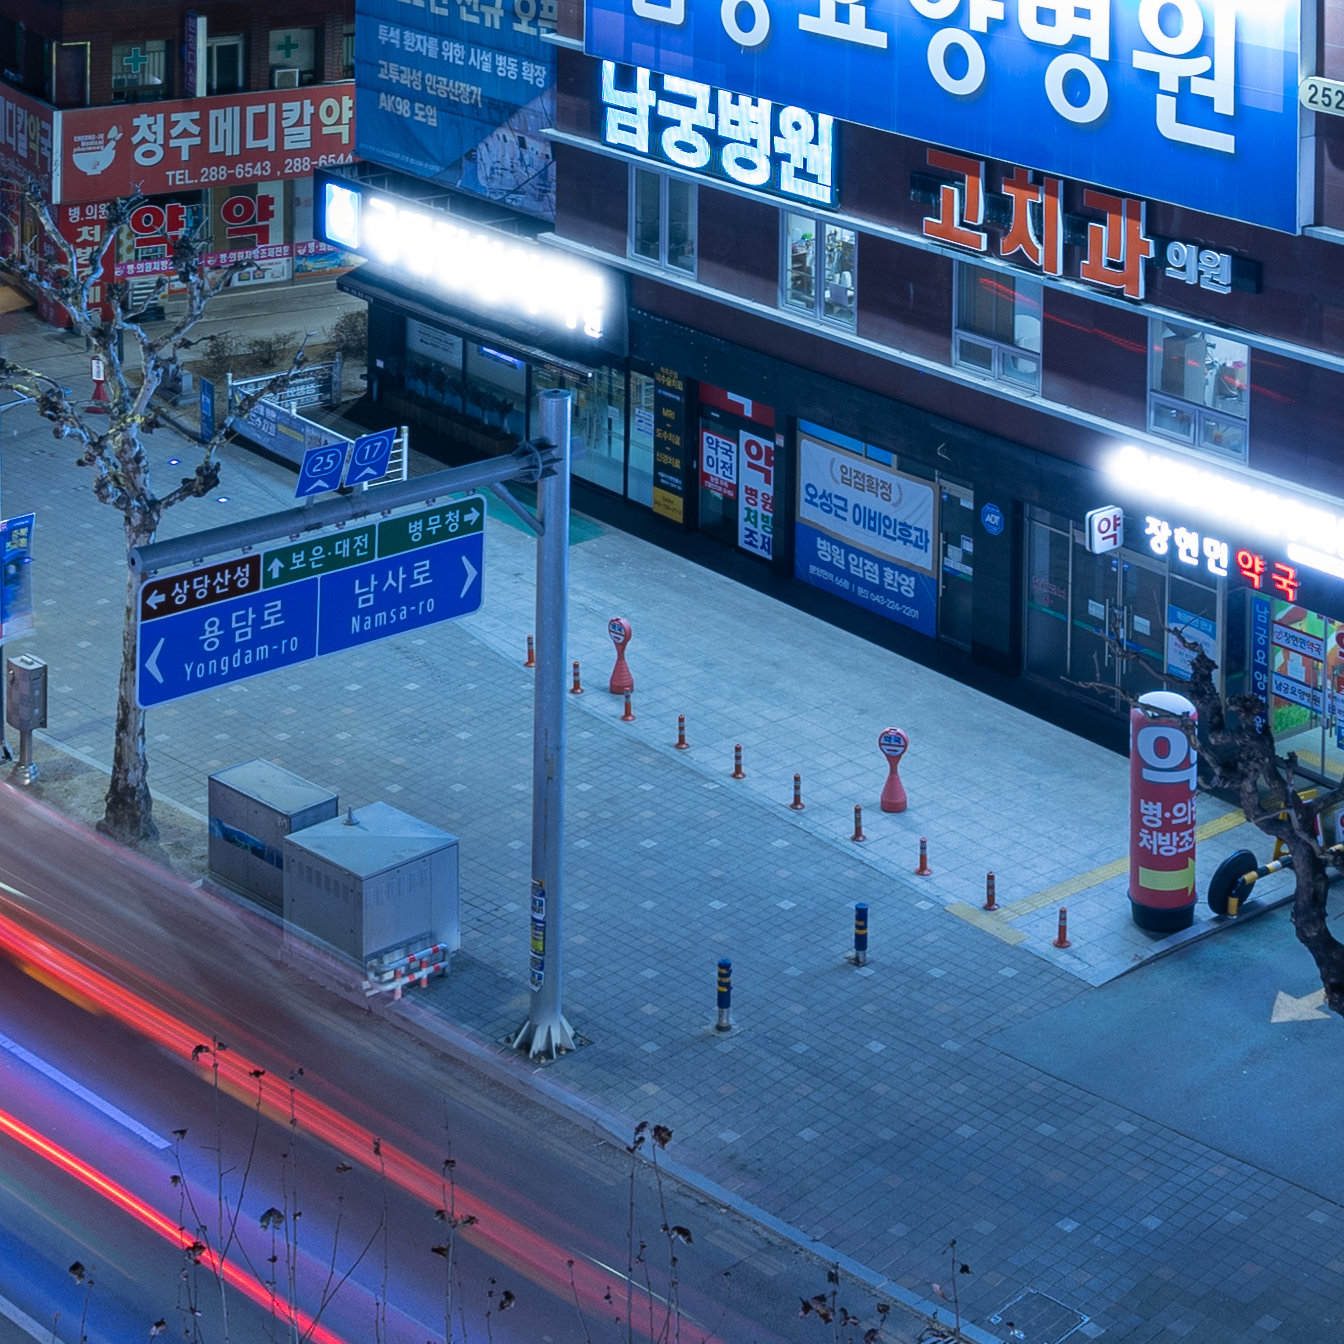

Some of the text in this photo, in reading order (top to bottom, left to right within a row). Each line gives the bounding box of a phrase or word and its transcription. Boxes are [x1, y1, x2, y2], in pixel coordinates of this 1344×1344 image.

[378, 24, 547, 88] 투석 환자를 위한 시설 병동 확장
[378, 60, 482, 108] 고투과성 인공신장기
[378, 92, 438, 127] AK98 도입
[601, 60, 833, 205] 남궁병원
[129, 203, 190, 256] 약
[220, 194, 276, 245] 약
[923, 149, 1233, 301] 고치과 의원
[661, 407, 675, 420] MRI
[362, 441, 382, 463] 17
[656, 428, 681, 446] 도수치료
[706, 435, 734, 462] 약국
[313, 452, 335, 475] 25
[706, 455, 733, 481] 이전
[744, 439, 775, 486] 약
[744, 485, 775, 513] 병원
[840, 464, 893, 503] 입점확정
[408, 509, 461, 543] 병무청
[804, 482, 930, 553] 오성근 이비인후과
[985, 512, 1002, 527] ADT
[1097, 514, 1122, 547] 약
[290, 533, 370, 572] 보은·대전
[816, 536, 915, 598] 병원 입점 환영
[170, 563, 251, 606] 상당산성
[354, 560, 433, 609] 남사로
[835, 576, 850, 590] 66평
[857, 586, 870, 600] 문의
[199, 599, 285, 652] 용담로
[351, 598, 436, 635] Namsa-ro
[184, 635, 299, 682] Yongdam-ro
[1283, 631, 1322, 656] 장현민약국
[1274, 679, 1321, 707] 남궁요양병원
